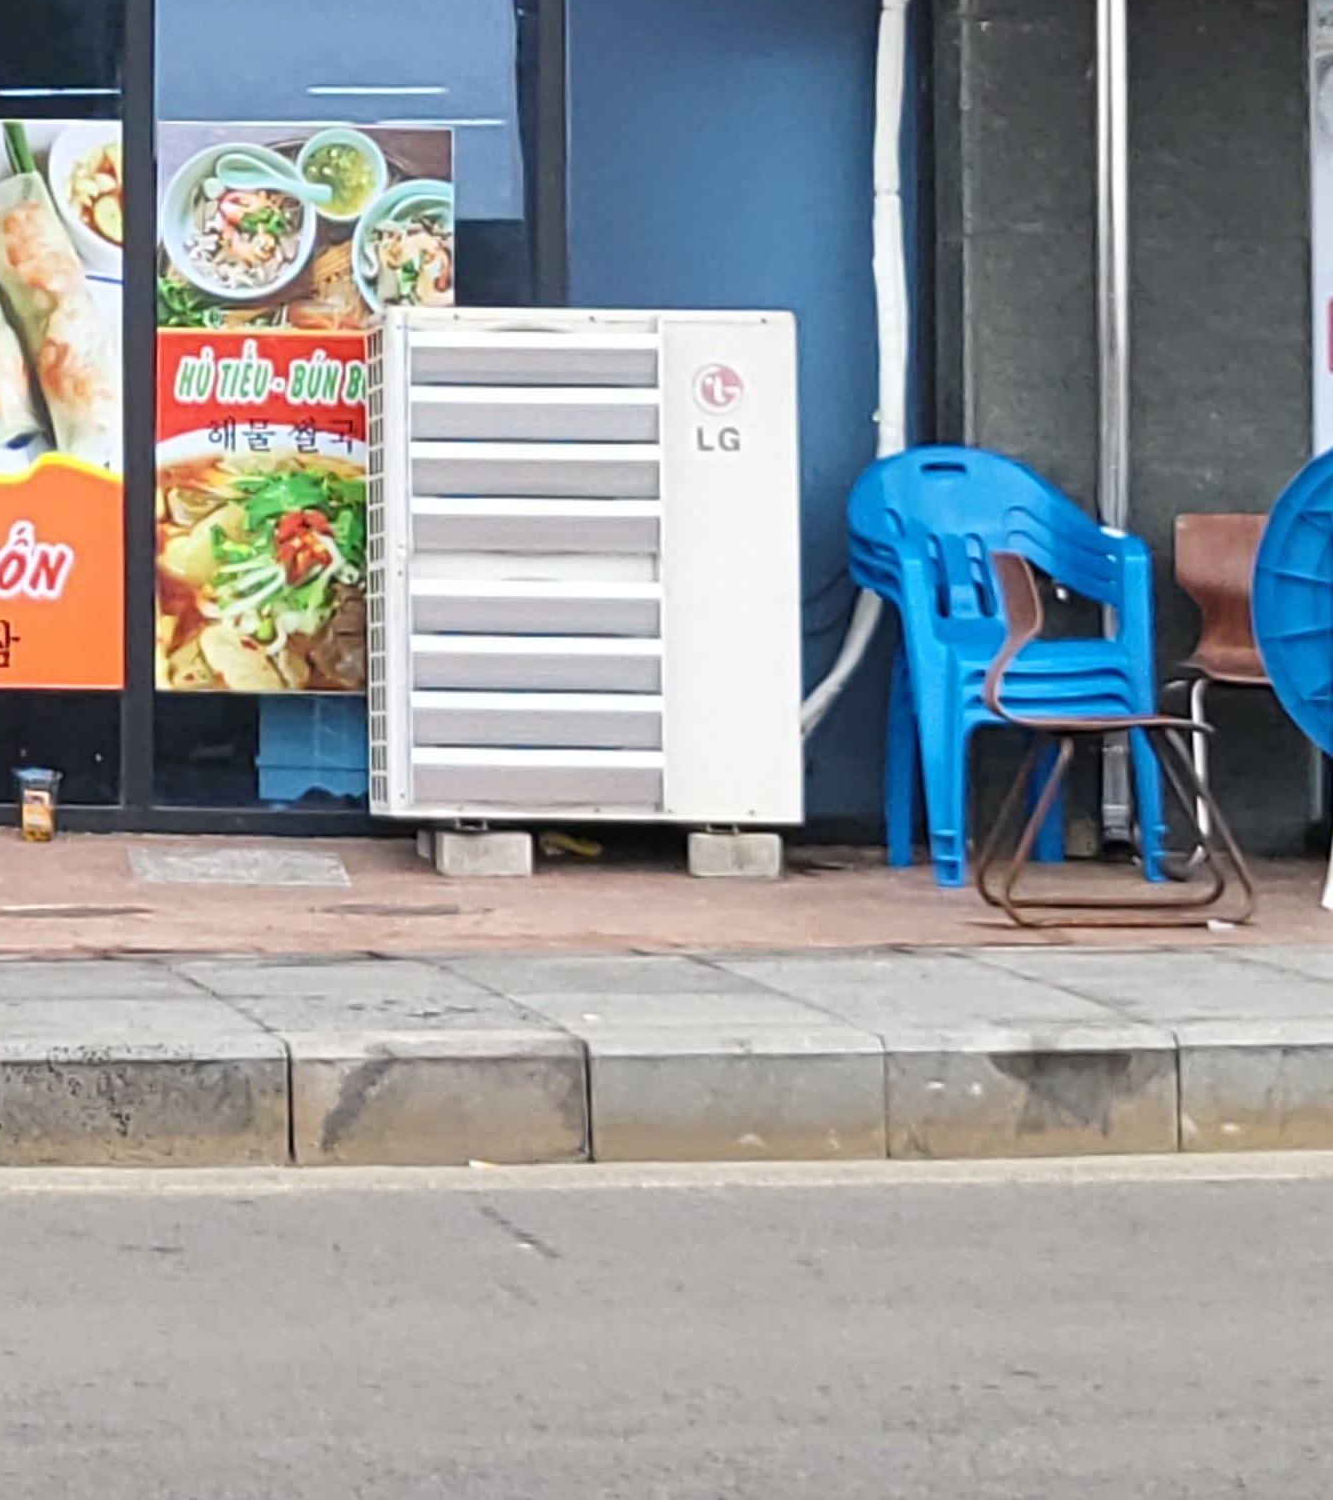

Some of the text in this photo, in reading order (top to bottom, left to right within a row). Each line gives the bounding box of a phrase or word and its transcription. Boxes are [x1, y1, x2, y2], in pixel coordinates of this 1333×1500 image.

[288, 351, 341, 402] BÚN
[344, 362, 366, 402] B
[696, 426, 741, 452] LG
